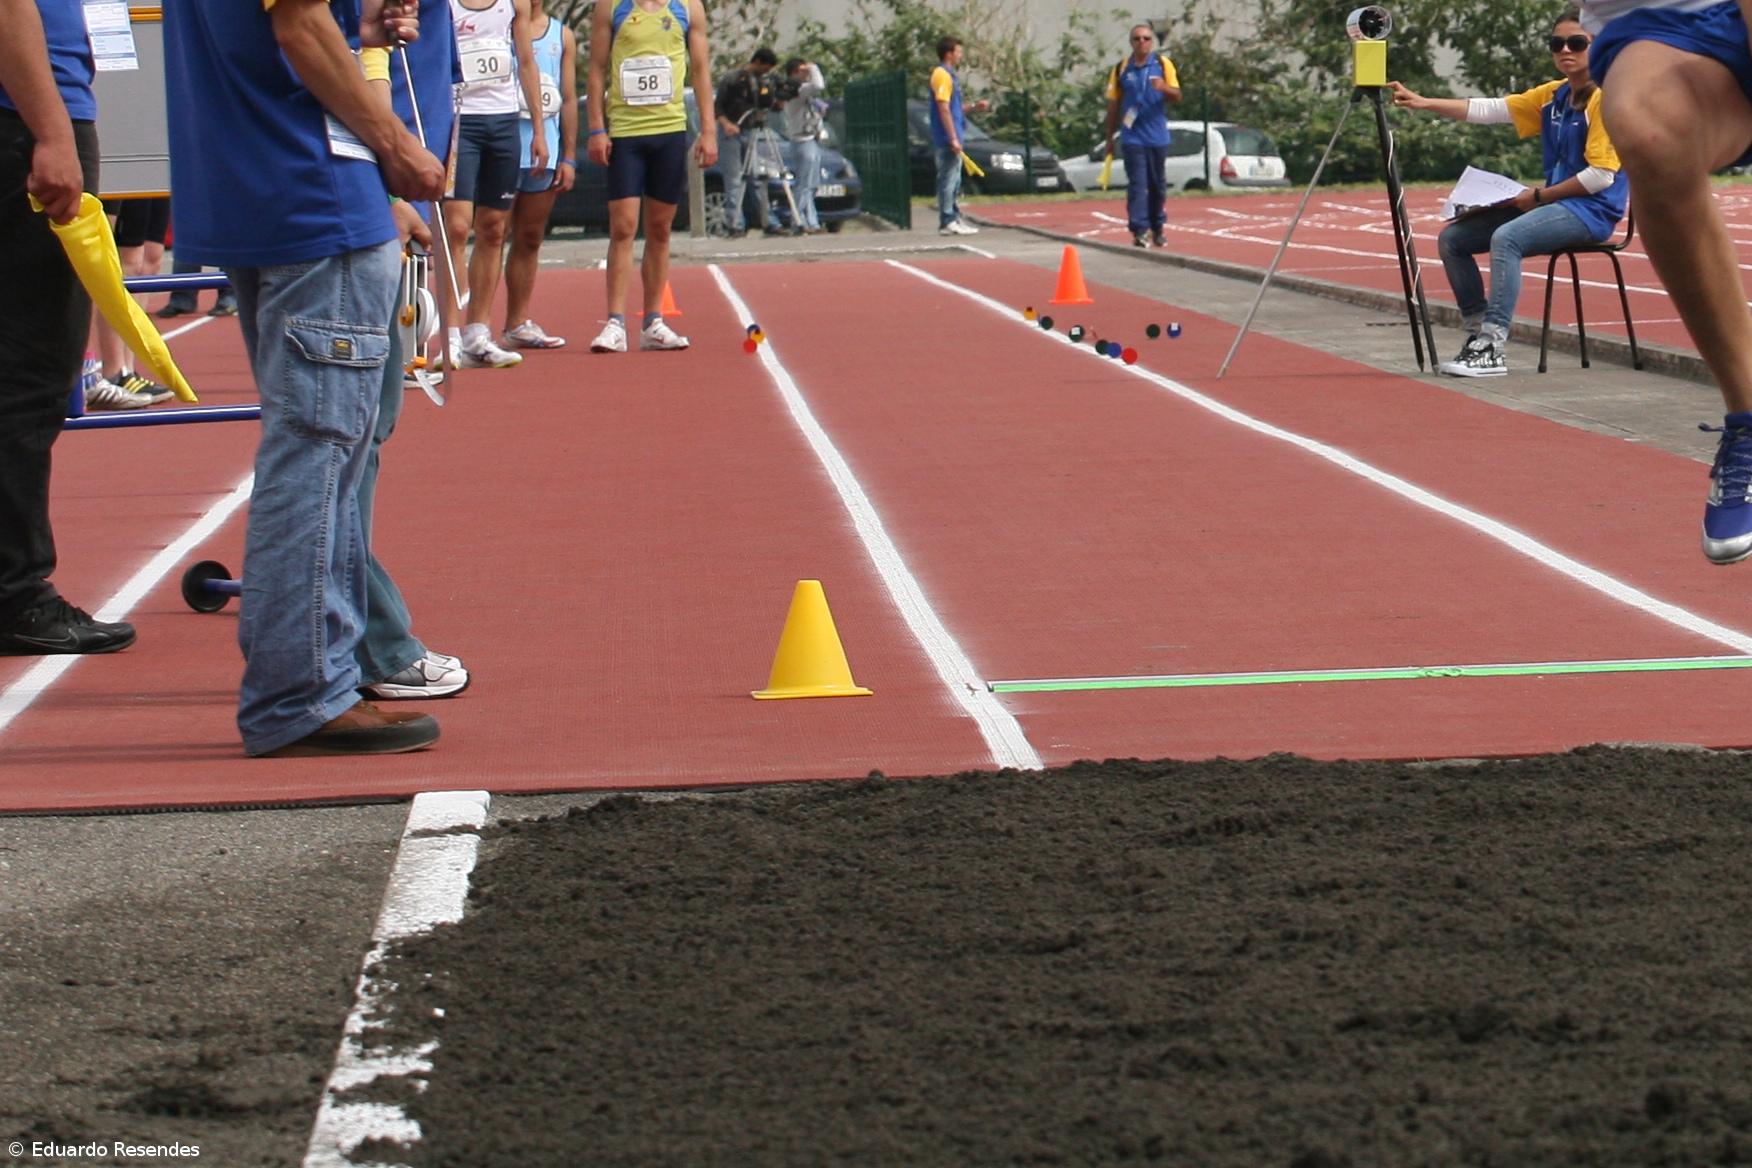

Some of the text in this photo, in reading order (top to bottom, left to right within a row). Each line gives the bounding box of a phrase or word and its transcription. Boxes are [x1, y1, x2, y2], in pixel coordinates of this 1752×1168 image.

[476, 56, 499, 74] 30
[637, 75, 659, 91] 58
[542, 92, 551, 107] 9
